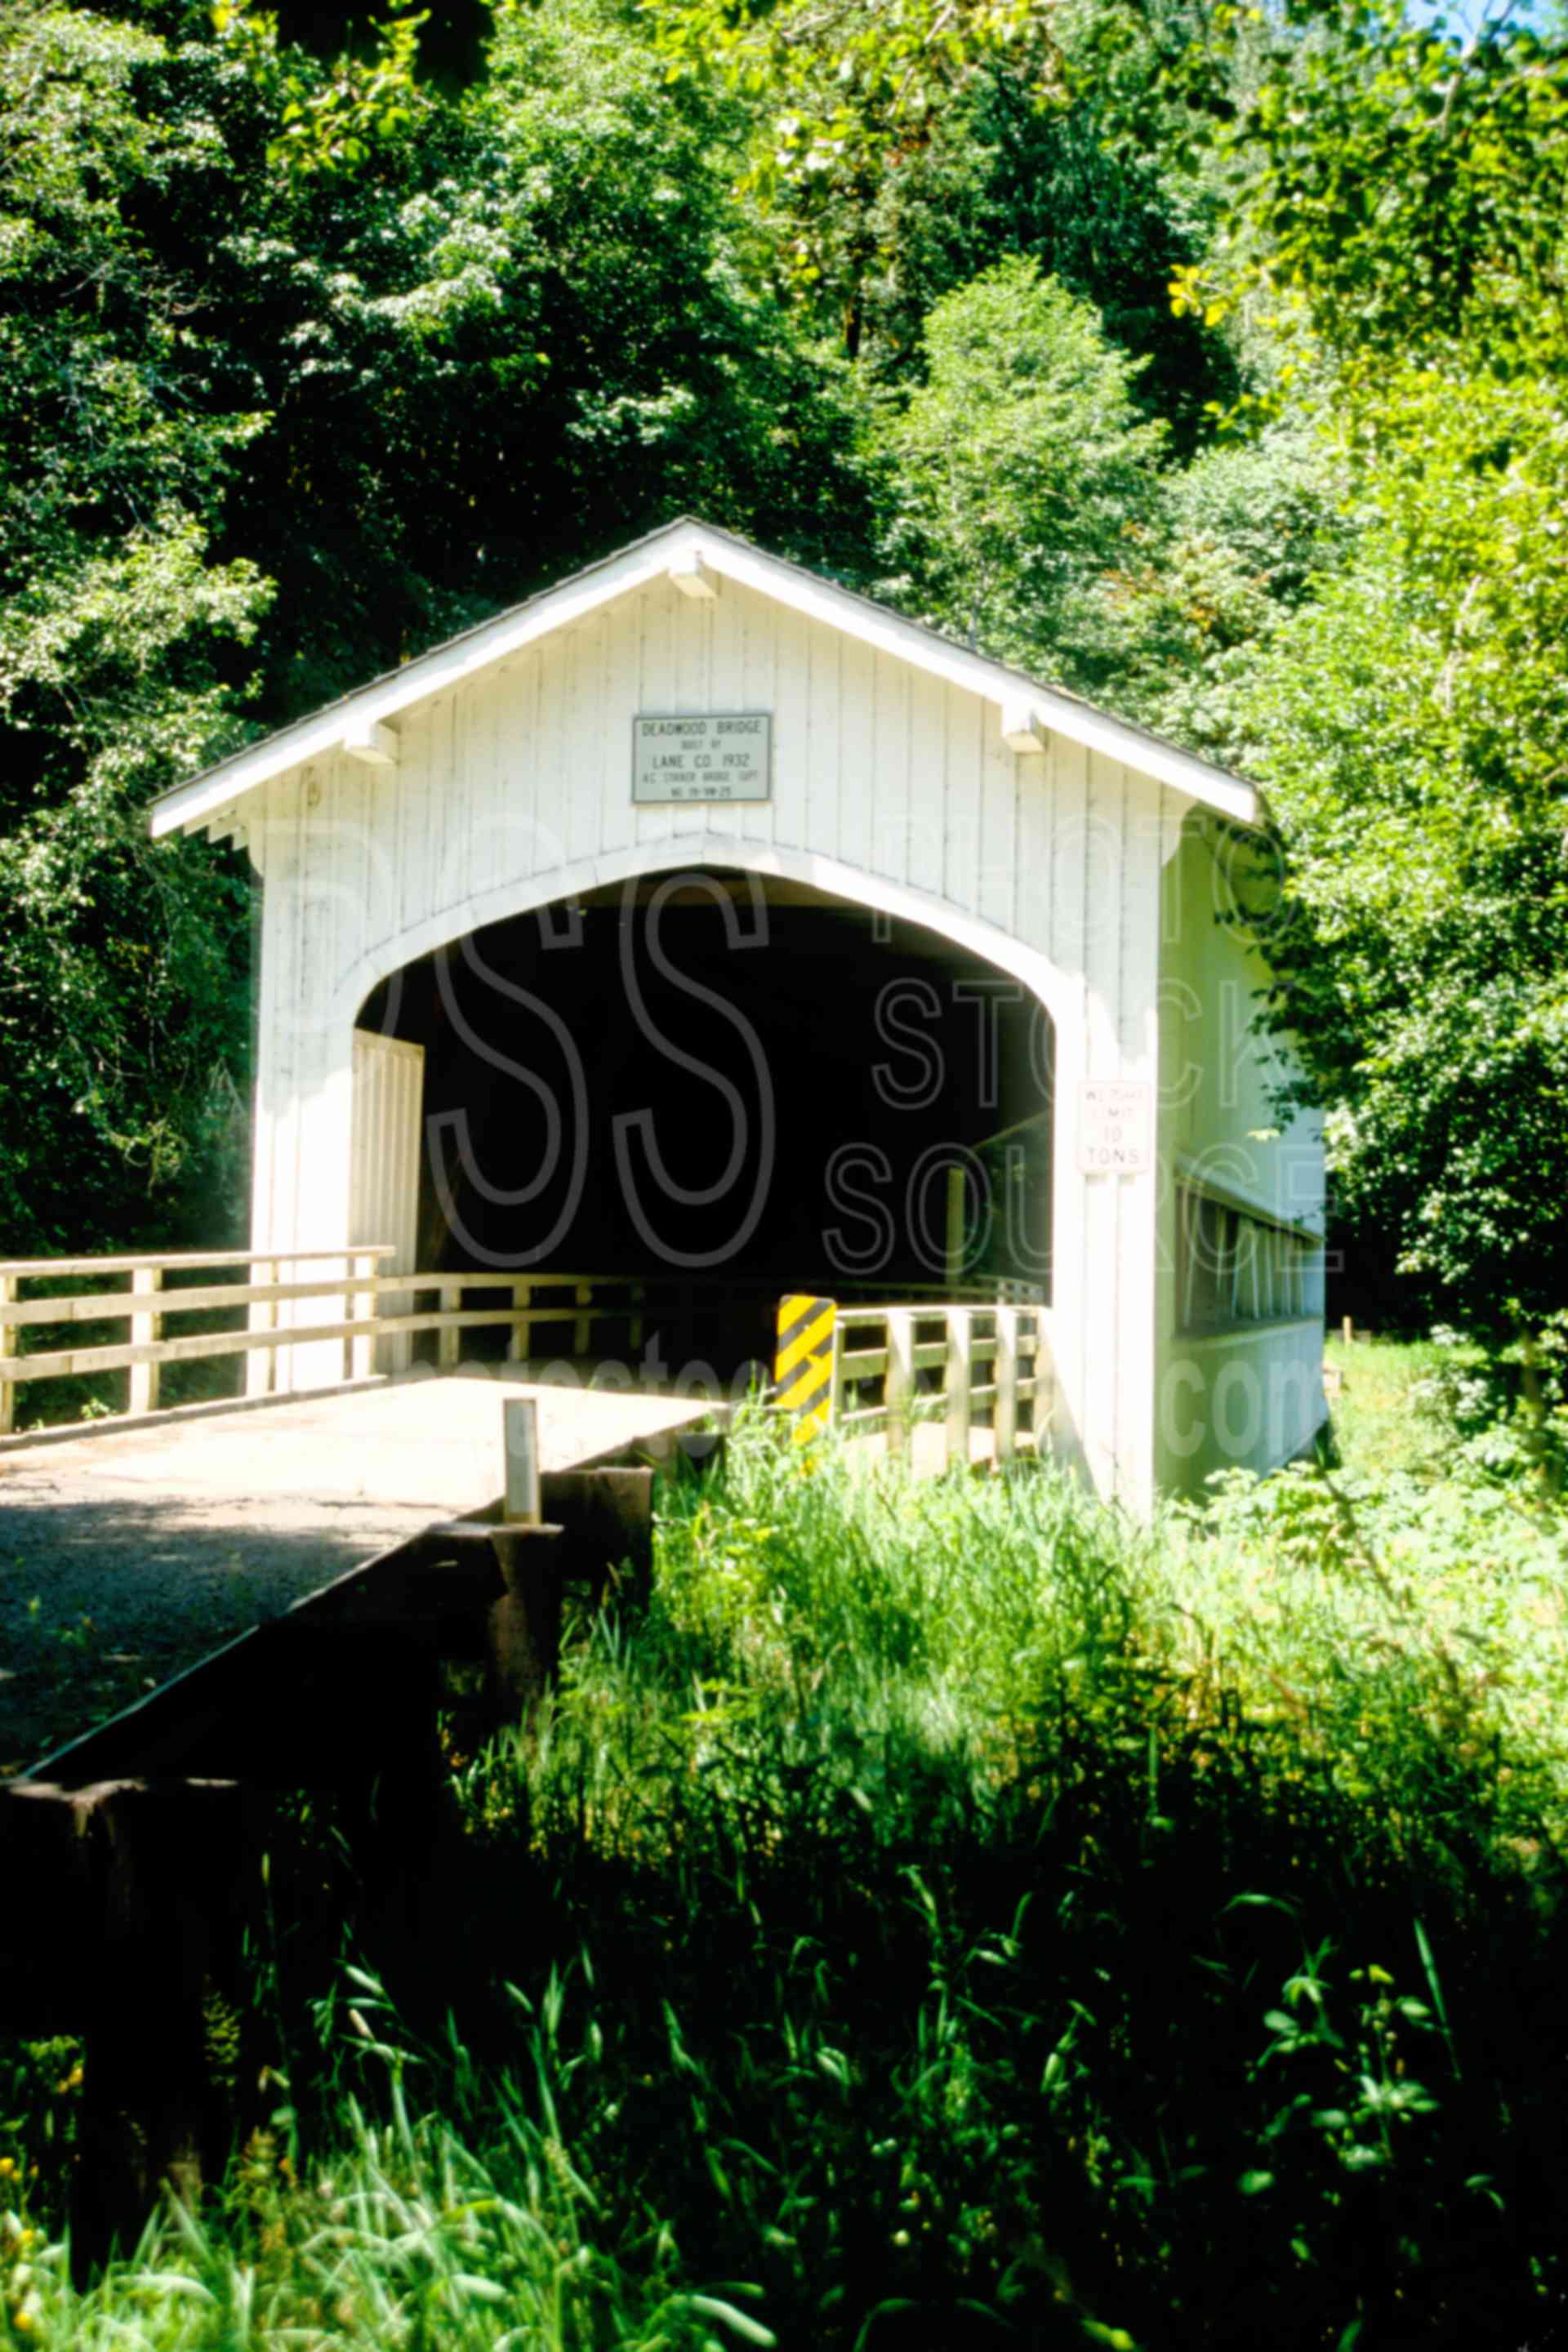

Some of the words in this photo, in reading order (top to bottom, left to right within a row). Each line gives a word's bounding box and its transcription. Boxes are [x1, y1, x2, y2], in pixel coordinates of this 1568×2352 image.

[641, 721, 706, 737] DEADWOOD
[716, 719, 761, 734] BRIDGE
[652, 754, 684, 769] LANE
[723, 753, 750, 768] 1932
[1086, 1147, 1139, 1165] TONS
